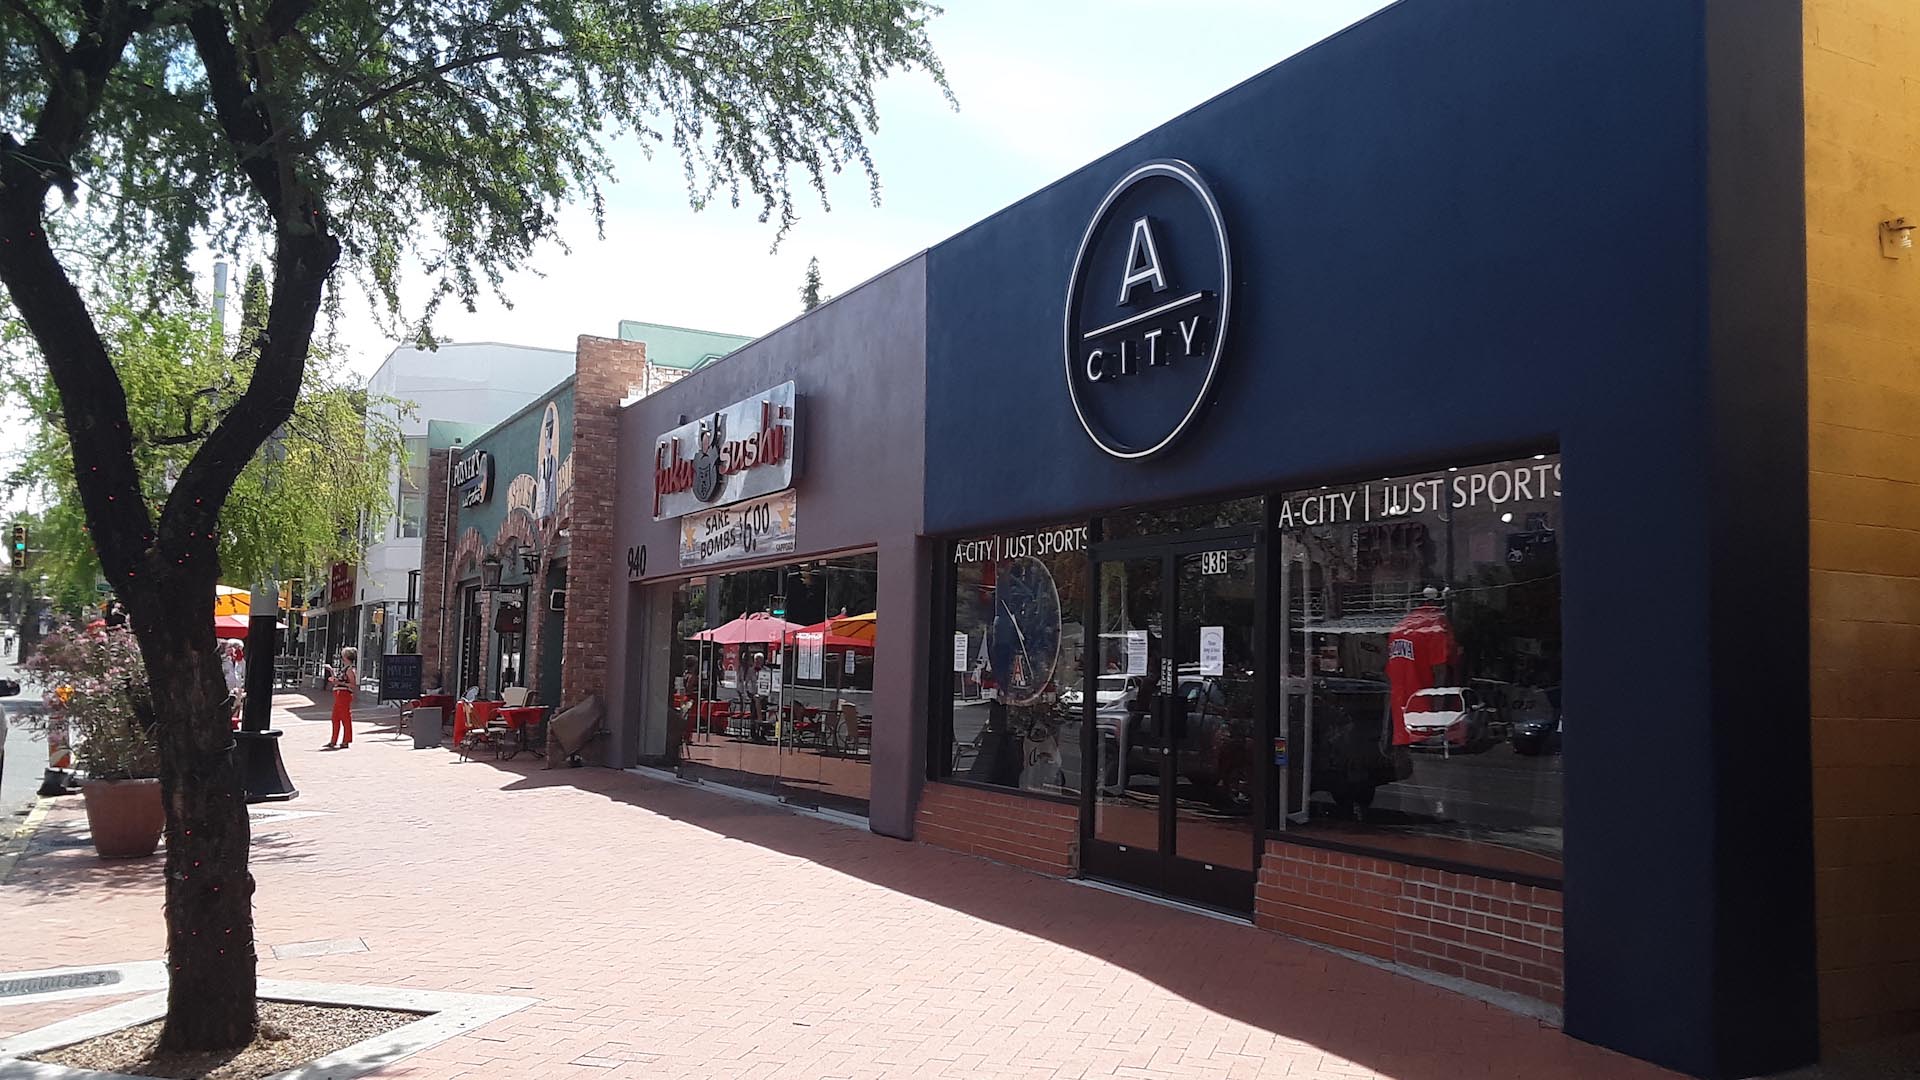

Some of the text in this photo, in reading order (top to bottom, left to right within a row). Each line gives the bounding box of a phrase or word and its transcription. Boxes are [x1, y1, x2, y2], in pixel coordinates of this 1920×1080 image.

[1117, 216, 1167, 306] A
[1086, 315, 1199, 381] CITY
[719, 399, 785, 475] sushi
[705, 508, 730, 536] SAKE
[1278, 491, 1357, 529] A-CITY
[1380, 478, 1444, 517] JUST
[627, 545, 647, 578] 940
[700, 528, 736, 560] BOMBS
[953, 540, 994, 563] A-CITY
[1004, 534, 1034, 559] JUST
[1037, 526, 1088, 555] SPORTS
[1203, 551, 1226, 573] 936
